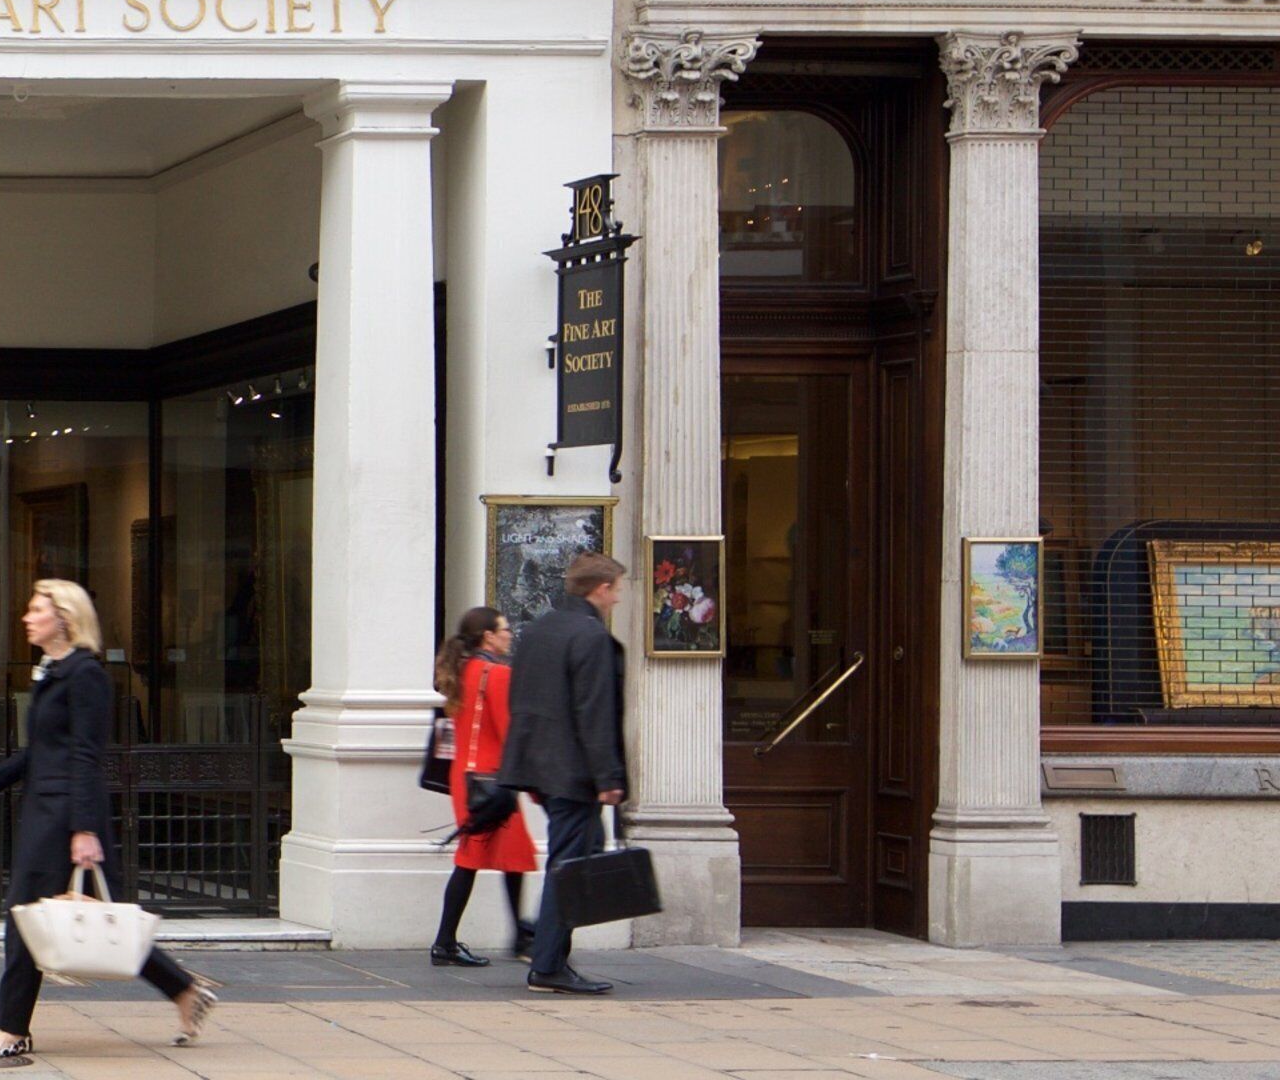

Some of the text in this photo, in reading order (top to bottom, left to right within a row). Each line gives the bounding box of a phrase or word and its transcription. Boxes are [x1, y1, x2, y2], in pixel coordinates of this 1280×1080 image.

[575, 184, 602, 240] 148
[578, 289, 603, 309] THE
[563, 318, 617, 343] FINE ART
[564, 350, 614, 373] SOCIETY
